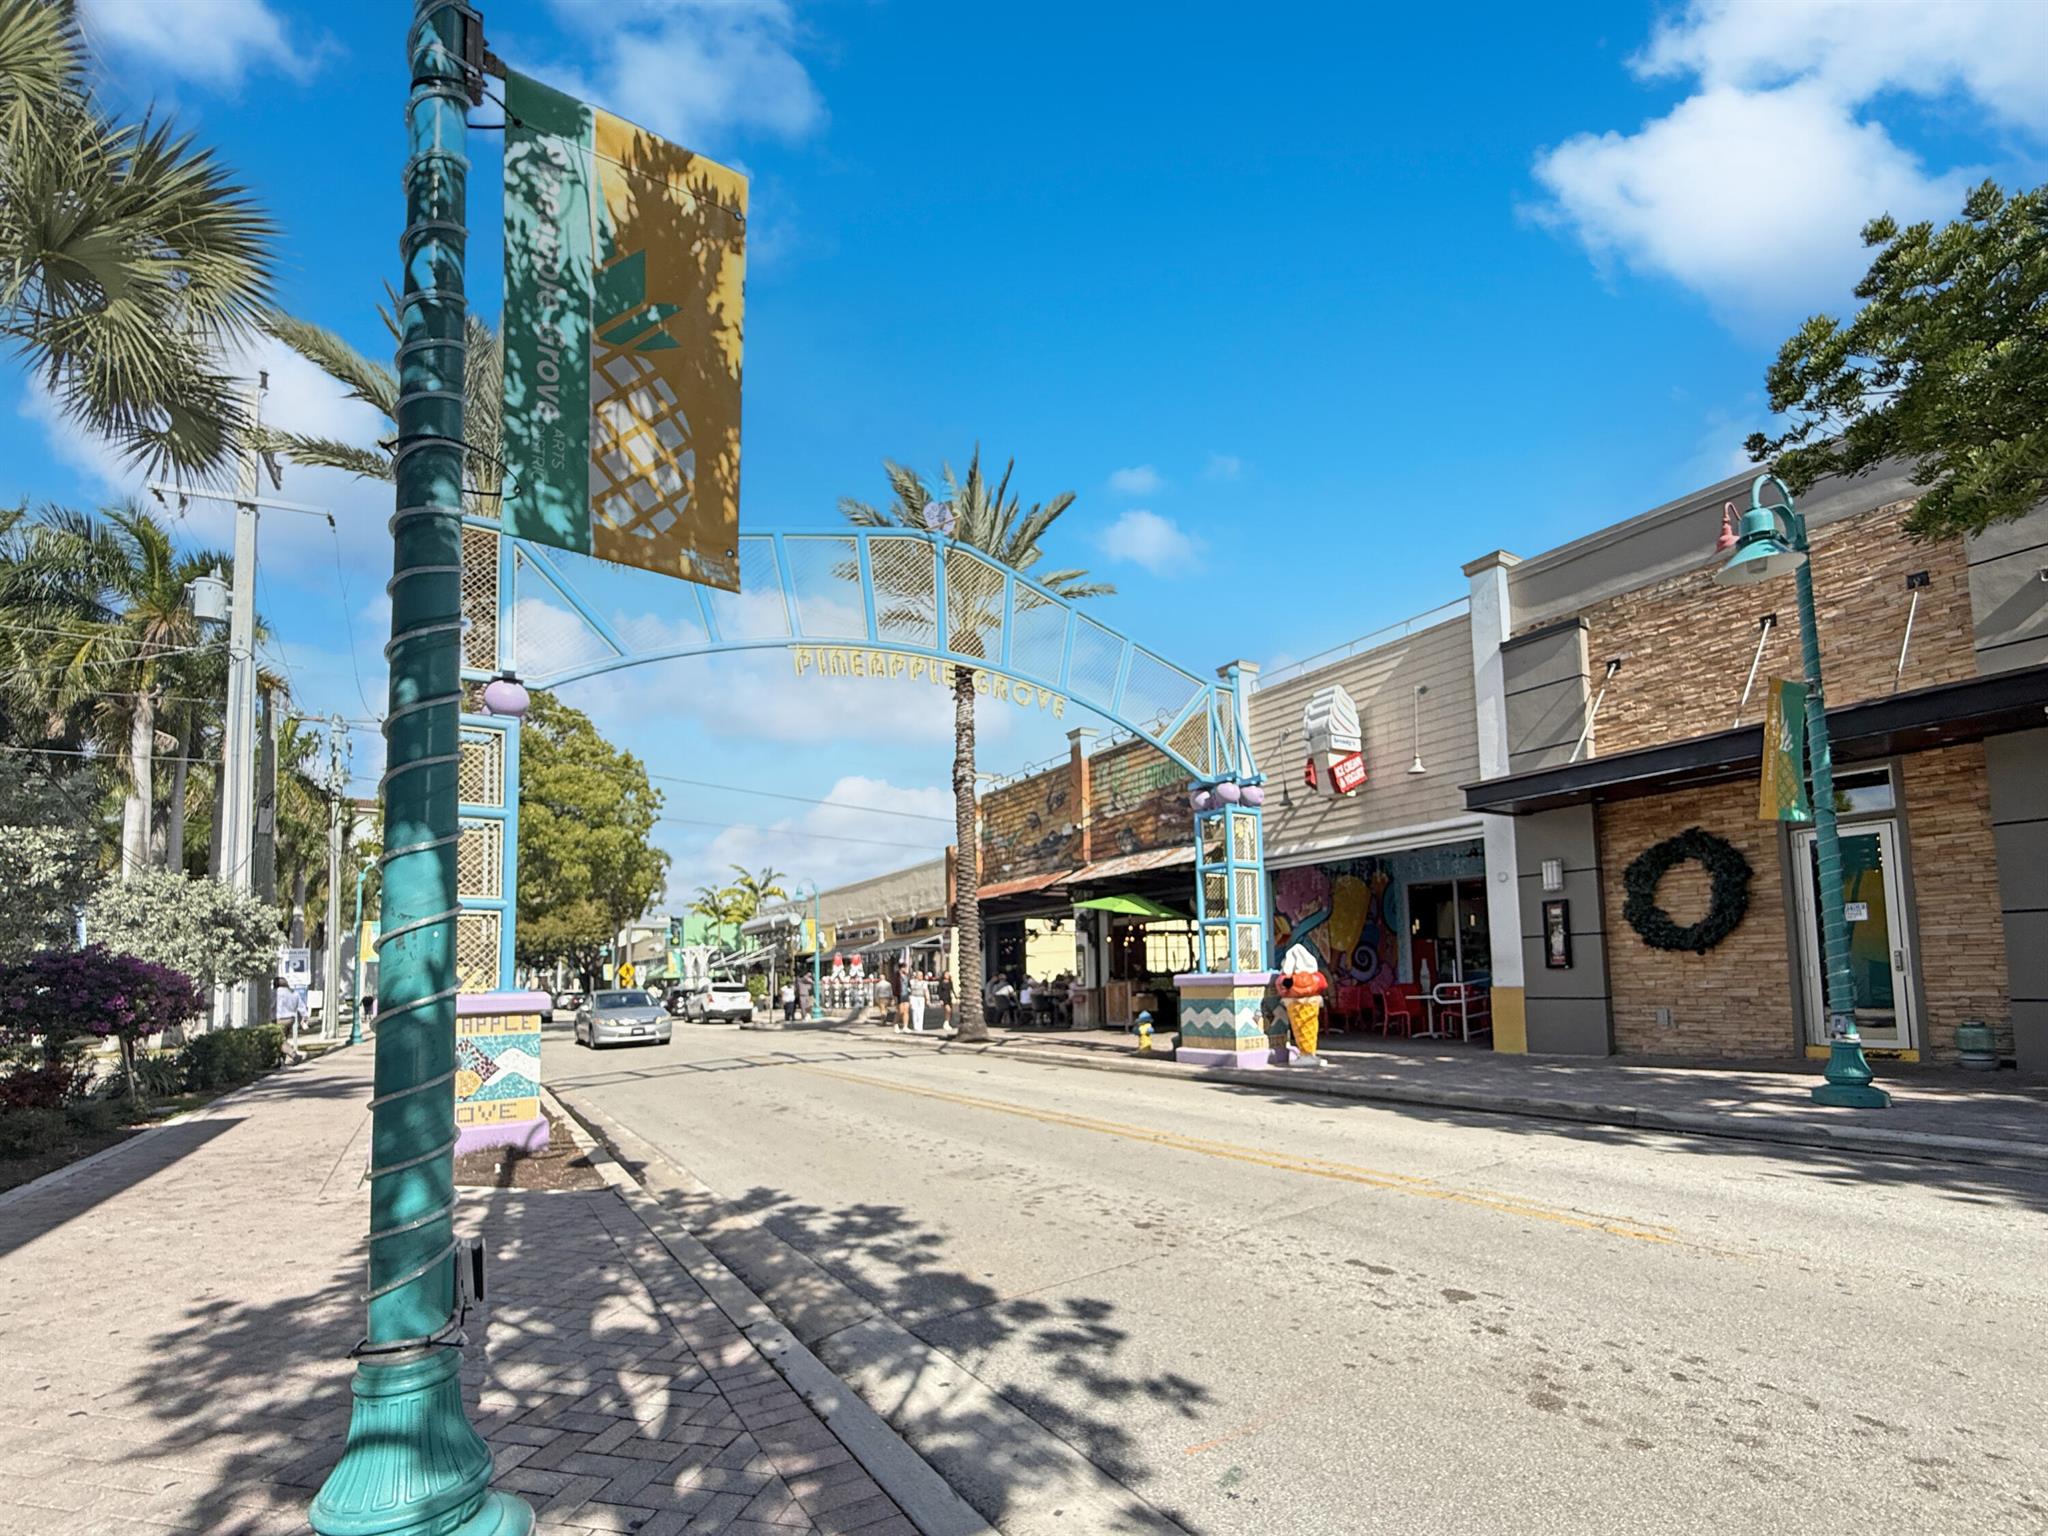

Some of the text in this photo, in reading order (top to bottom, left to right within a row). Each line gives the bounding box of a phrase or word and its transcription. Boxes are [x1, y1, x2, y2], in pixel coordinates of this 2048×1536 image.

[530, 135, 567, 421] Pineapple Grove
[551, 426, 565, 471] ARTS
[793, 648, 1066, 721] PINEAPPLE GROVE
